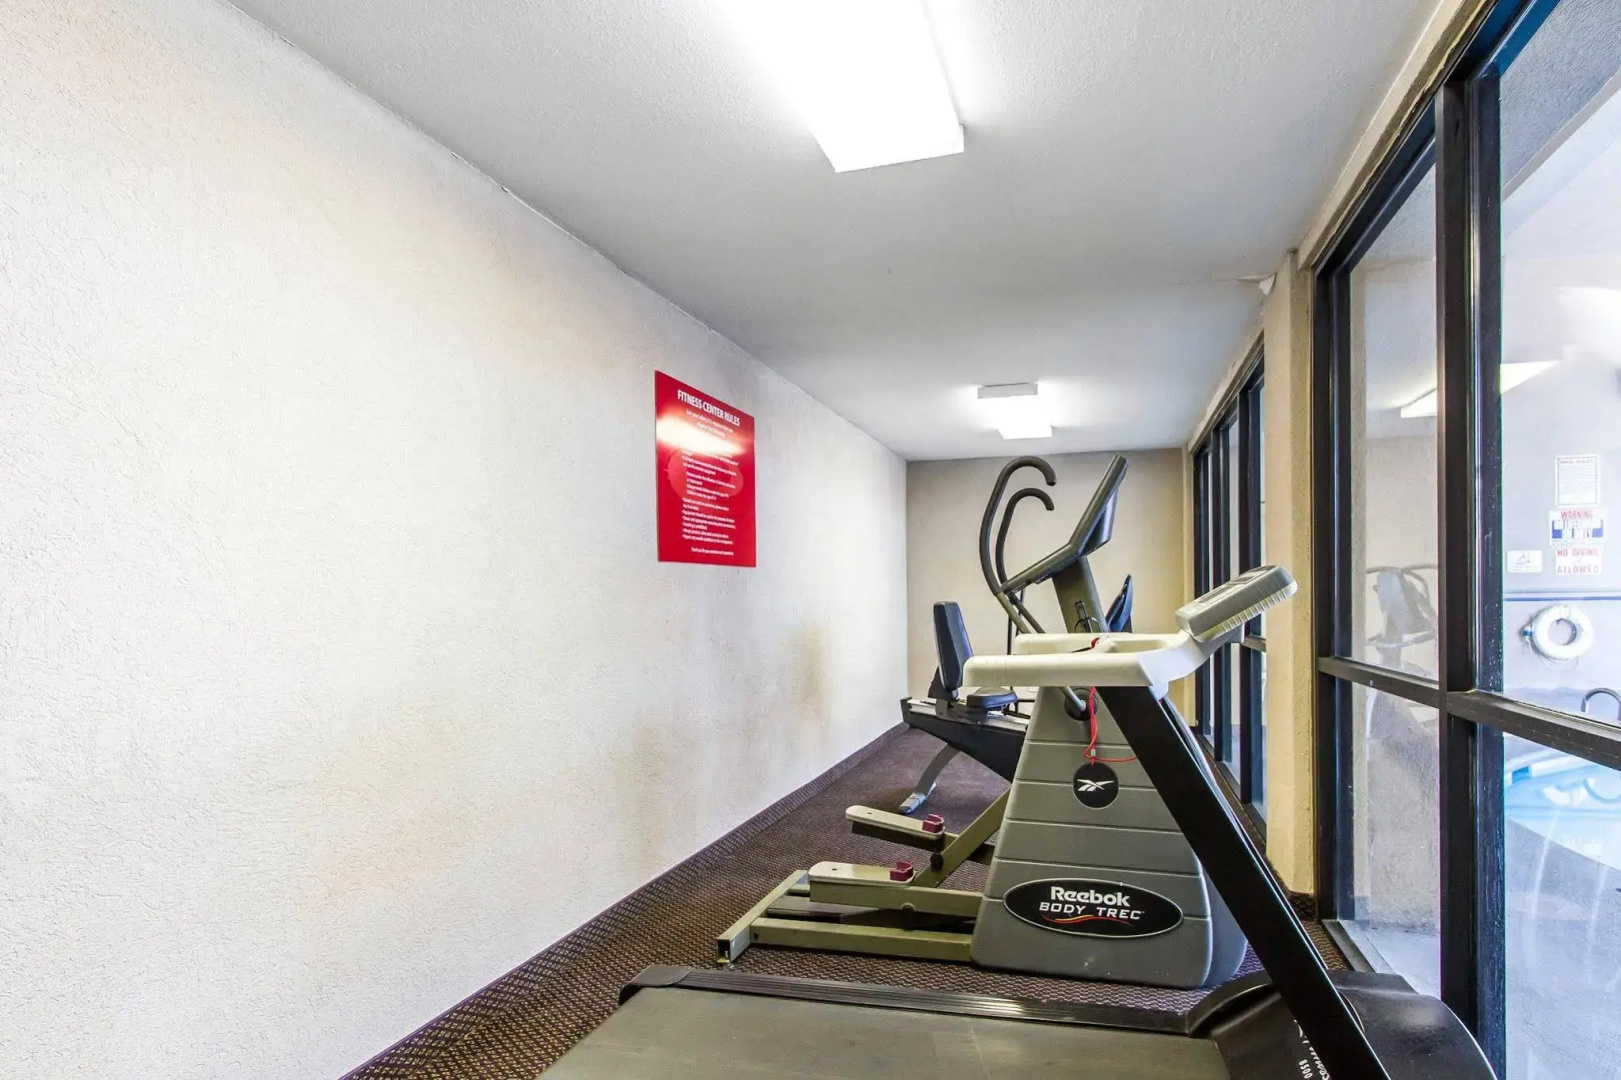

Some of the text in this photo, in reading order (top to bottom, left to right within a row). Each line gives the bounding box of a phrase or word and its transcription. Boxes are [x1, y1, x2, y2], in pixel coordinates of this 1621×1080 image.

[677, 389, 702, 409] FITNESS
[702, 401, 725, 419] CENTER
[724, 411, 740, 427] RULES
[1560, 510, 1594, 519] WARNING
[1557, 548, 1599, 557] NO DIVING
[1557, 565, 1599, 573] ALLOWED
[1051, 886, 1131, 907] Reebok
[1039, 902, 1086, 915] BODY
[1299, 1059, 1313, 1079] 8500
